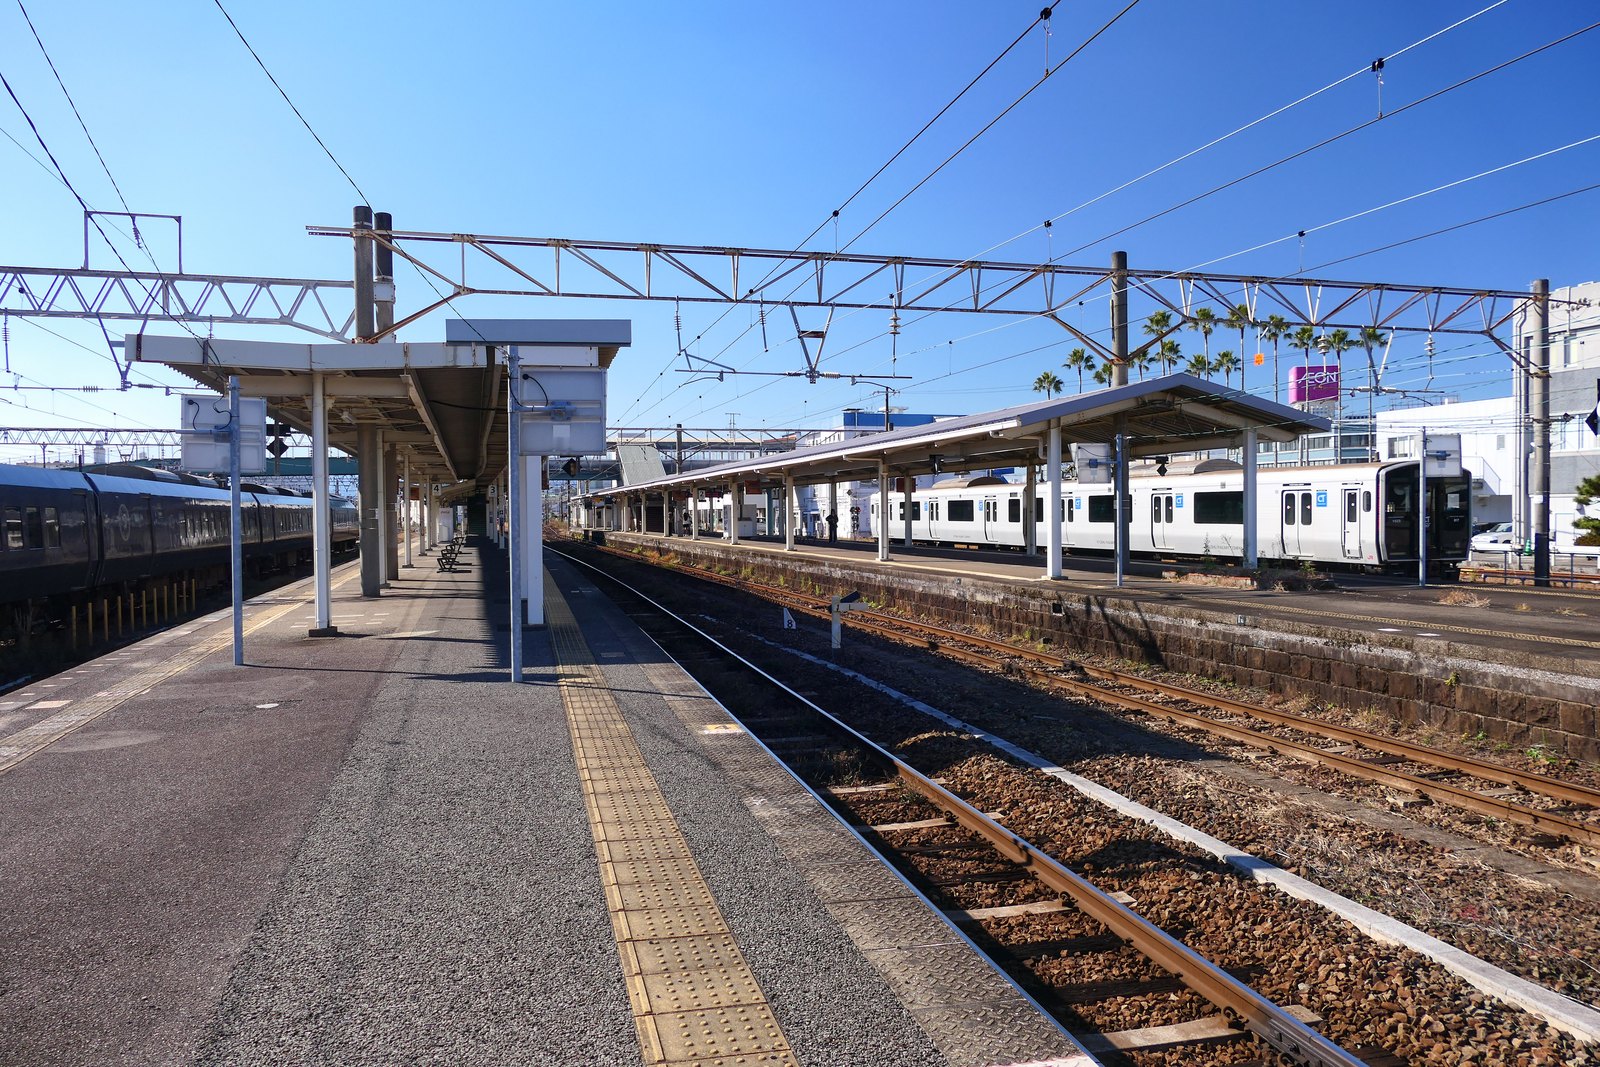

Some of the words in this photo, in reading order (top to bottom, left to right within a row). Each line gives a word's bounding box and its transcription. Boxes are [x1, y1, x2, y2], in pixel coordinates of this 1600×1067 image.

[490, 486, 496, 494] 3
[700, 489, 704, 497] 2
[787, 619, 793, 628] 8
